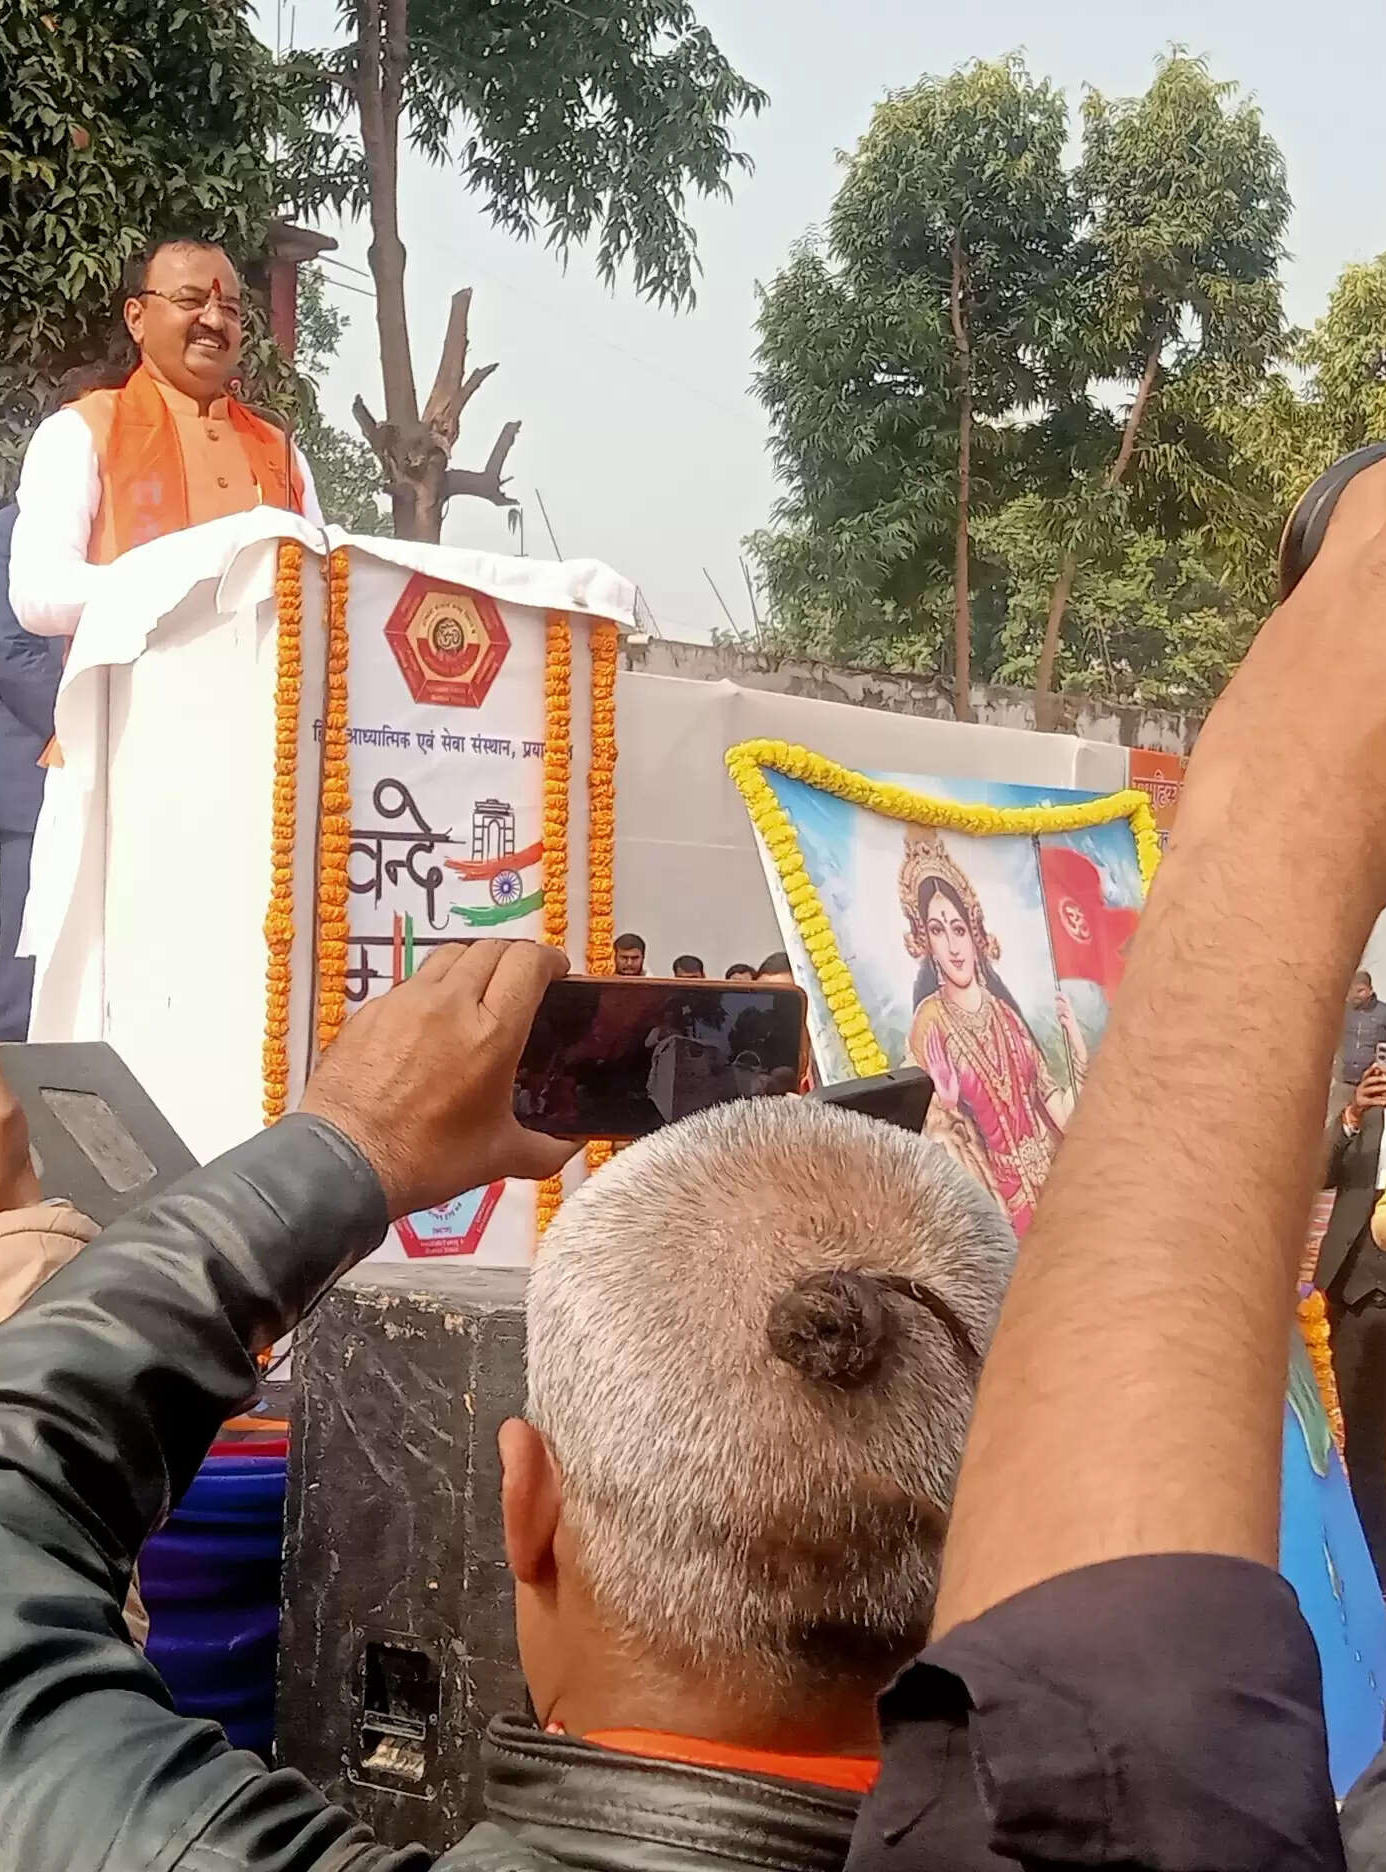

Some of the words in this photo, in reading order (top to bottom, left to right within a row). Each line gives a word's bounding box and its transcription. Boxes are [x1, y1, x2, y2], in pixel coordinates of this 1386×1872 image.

[346, 725, 411, 749] आध्यात्मिक
[416, 728, 436, 755] एवं
[441, 728, 465, 753] सेवा
[470, 733, 515, 760] संस्थान,
